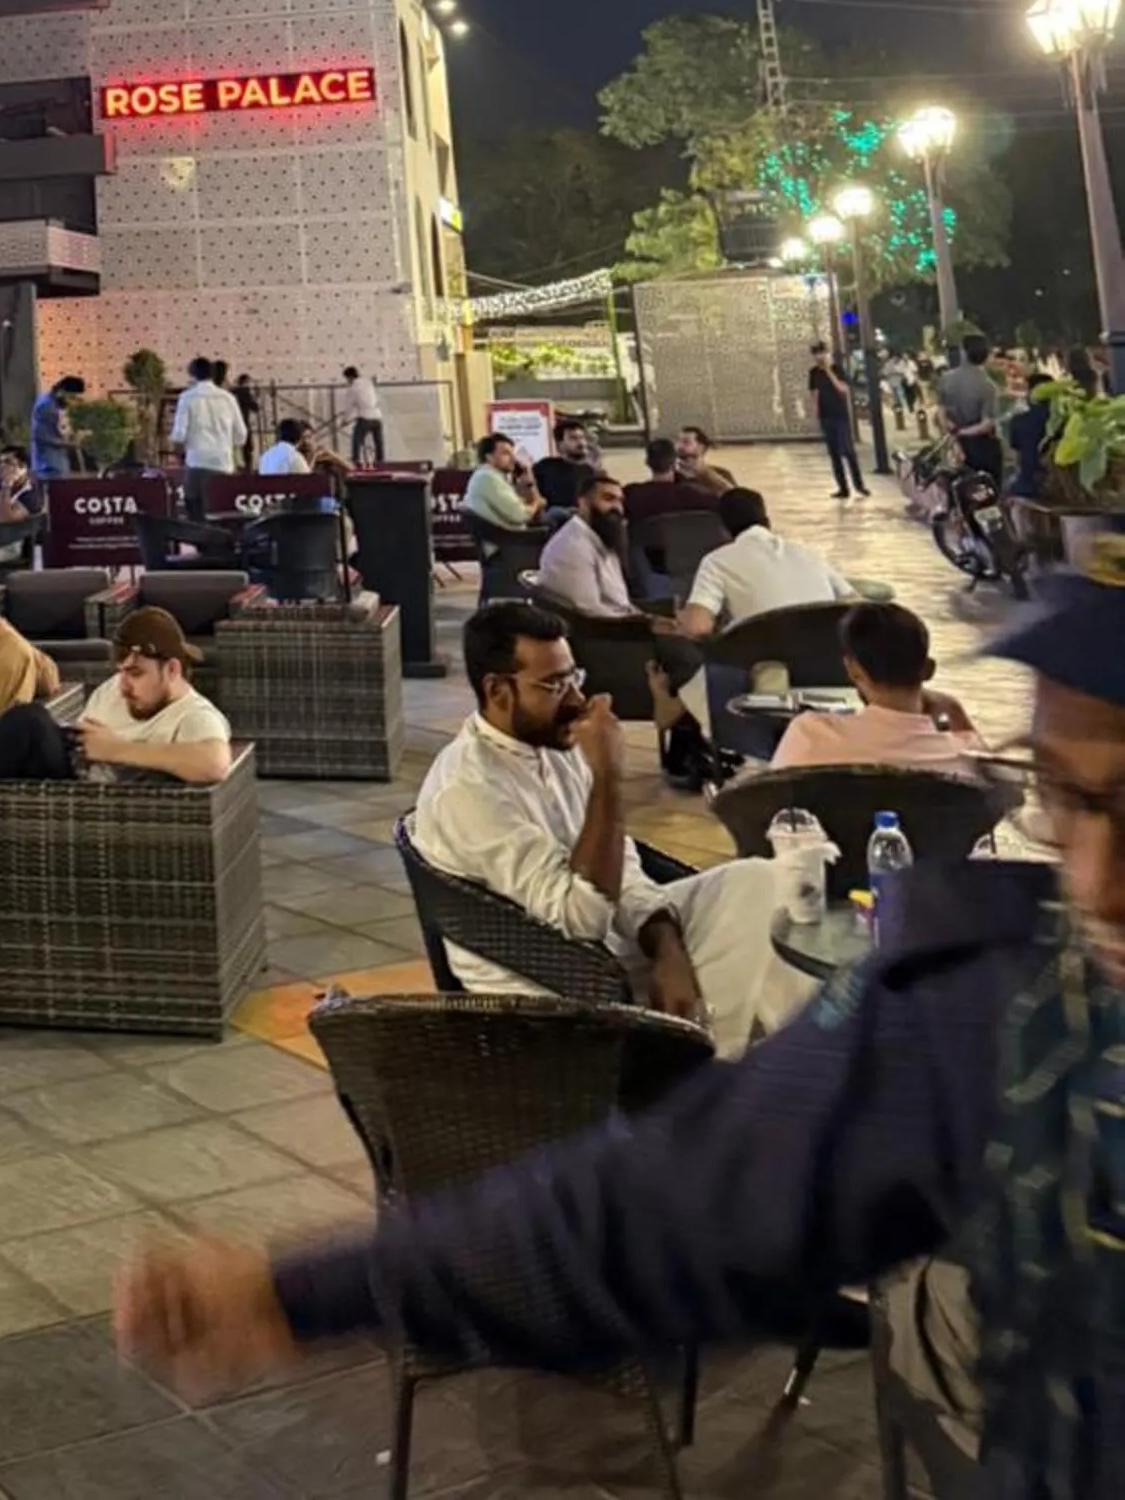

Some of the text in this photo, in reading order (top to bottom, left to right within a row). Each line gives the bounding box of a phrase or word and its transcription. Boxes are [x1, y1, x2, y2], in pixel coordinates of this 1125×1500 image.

[106, 70, 372, 116] ROSE PALACE
[74, 495, 138, 515] COSTA
